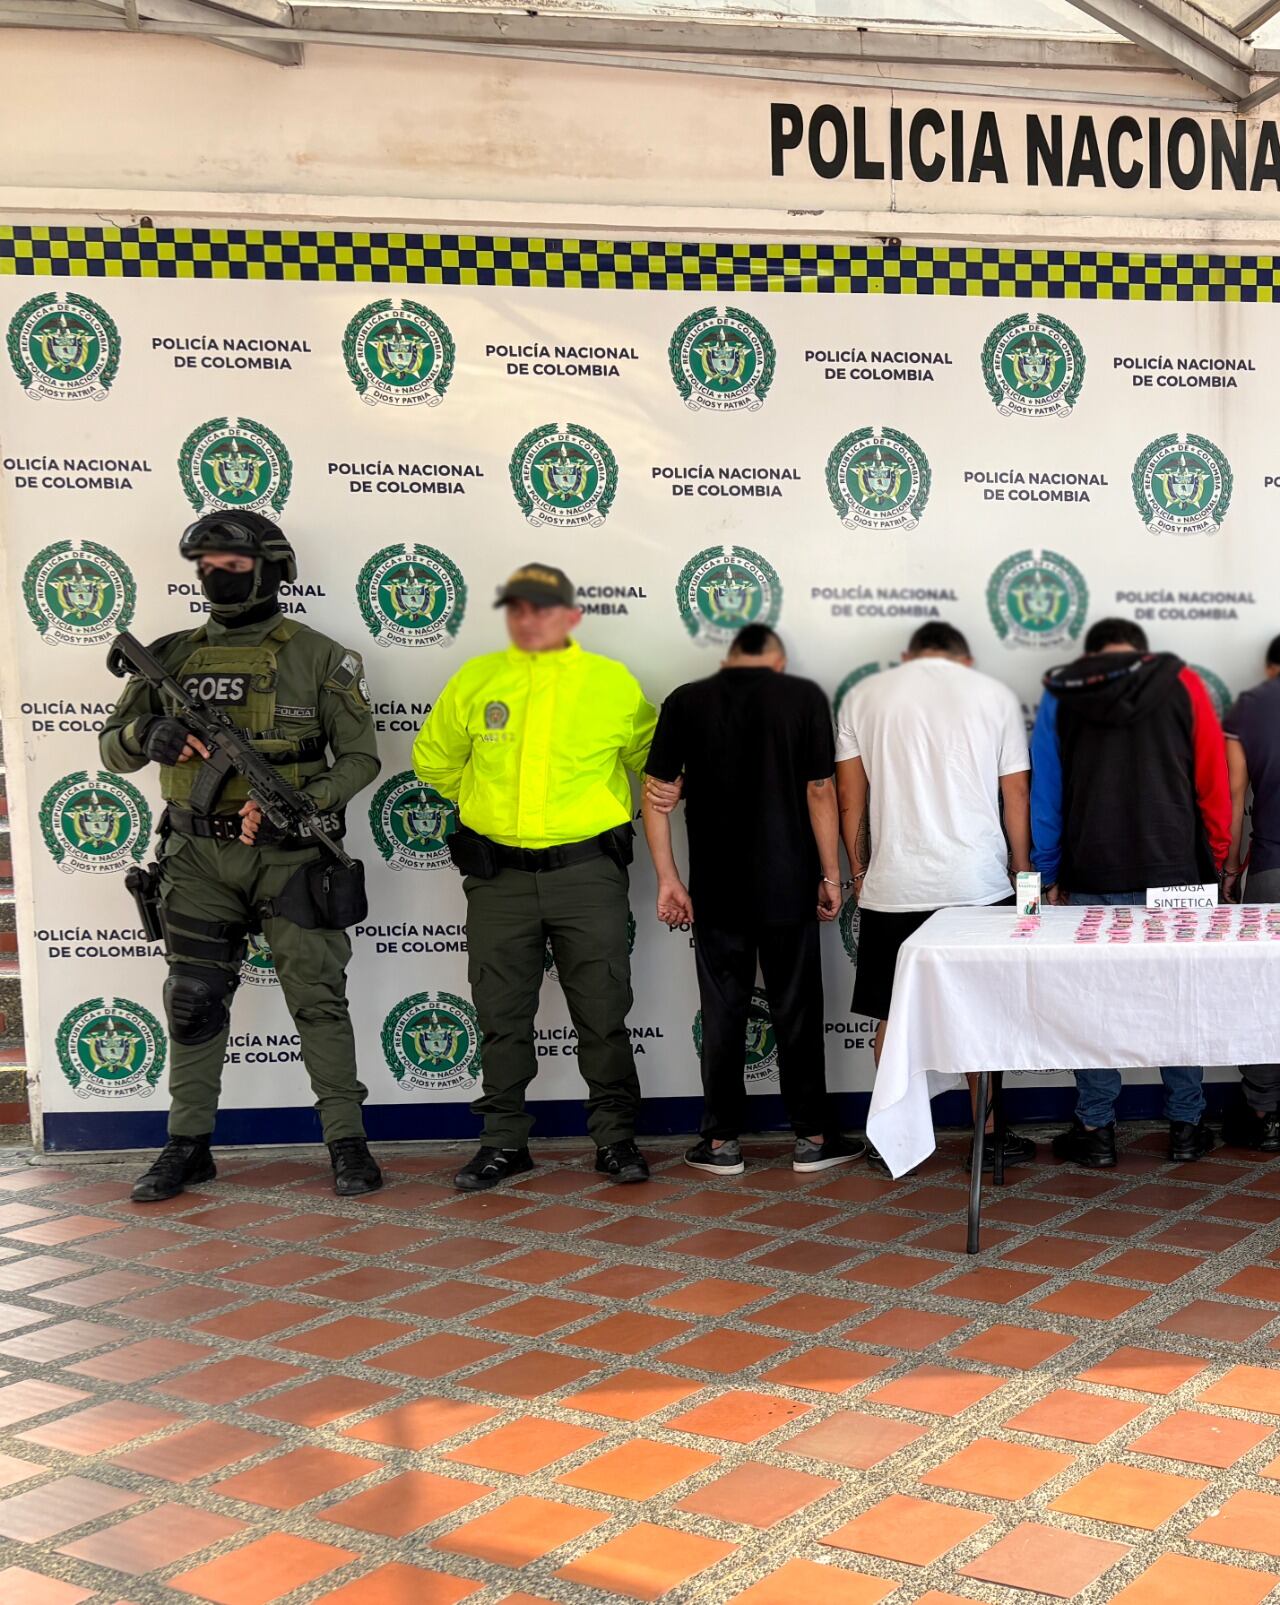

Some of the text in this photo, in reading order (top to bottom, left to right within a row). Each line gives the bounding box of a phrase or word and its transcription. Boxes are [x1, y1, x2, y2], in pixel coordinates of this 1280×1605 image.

[771, 103, 1008, 183] POLICIA
[152, 335, 311, 352] POLICÍA NACIONAL
[486, 343, 639, 359] POLICÍA NACIONAL
[805, 348, 952, 364] POLICÍA NACIONAL
[174, 356, 292, 370] DE COLOMBIA
[507, 363, 620, 376] DE COLOMBIA
[1114, 355, 1256, 371] POLICÍA NACIONAL
[825, 368, 934, 381] DE COLOMBIA
[1133, 375, 1238, 388] DE COLOMBIA
[3, 456, 152, 472] OLICÍA NACIONAL
[328, 461, 484, 477] POLICÍA NACIONAL
[652, 464, 801, 480] POLICÍA NACIONAL
[964, 469, 1108, 485] POLICÍA NACIONAL
[15, 476, 133, 489] DE COLOMBIA
[350, 481, 465, 494] DE COLOMBIA
[672, 484, 782, 497] DE COLOMBIA
[984, 489, 1090, 502] DE COLOMBIA
[280, 585, 326, 597] ONAL
[577, 586, 647, 598] ACIONAL
[876, 588, 958, 601] NACIONAL
[1178, 592, 1255, 603] NACIONAL
[831, 605, 940, 617] DE COLOMBIA
[1135, 608, 1154, 620] DE
[182, 677, 245, 701] GOES
[21, 700, 76, 714] OLICÍA
[32, 720, 105, 732] DE COLO
[1154, 898, 1213, 908] SINTETICA
[355, 922, 419, 937] POLICÍA
[49, 945, 165, 958] DE COLOMBIA
[376, 941, 468, 954] DE COLOMB
[844, 1038, 865, 1049] DE
[245, 1051, 304, 1063] COLOM
[538, 1045, 558, 1056] DE
